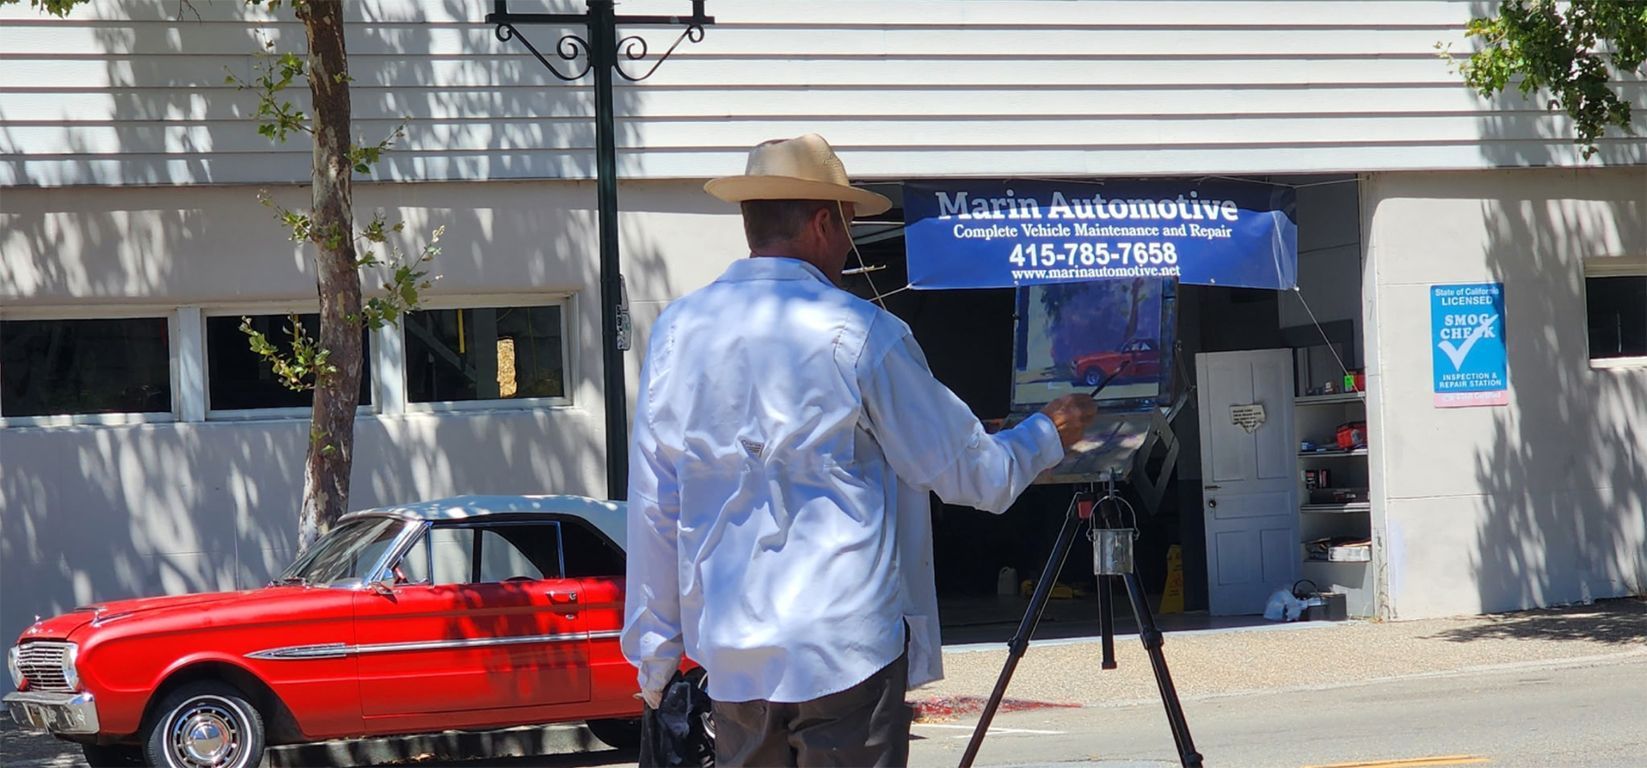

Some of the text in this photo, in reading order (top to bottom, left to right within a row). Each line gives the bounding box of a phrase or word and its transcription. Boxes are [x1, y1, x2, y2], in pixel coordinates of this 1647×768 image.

[935, 189, 1239, 221] Marin Automotive
[953, 223, 1232, 240] Complete Vehicle Maintenance and Repair
[1009, 242, 1178, 267] 415-785-7658
[1011, 264, 1181, 280] www.marinautomotive.net
[1435, 288, 1455, 297] State
[1442, 296, 1493, 306] LICENSED
[1442, 373, 1490, 381] INSPECTION
[1470, 380, 1502, 388] STATION
